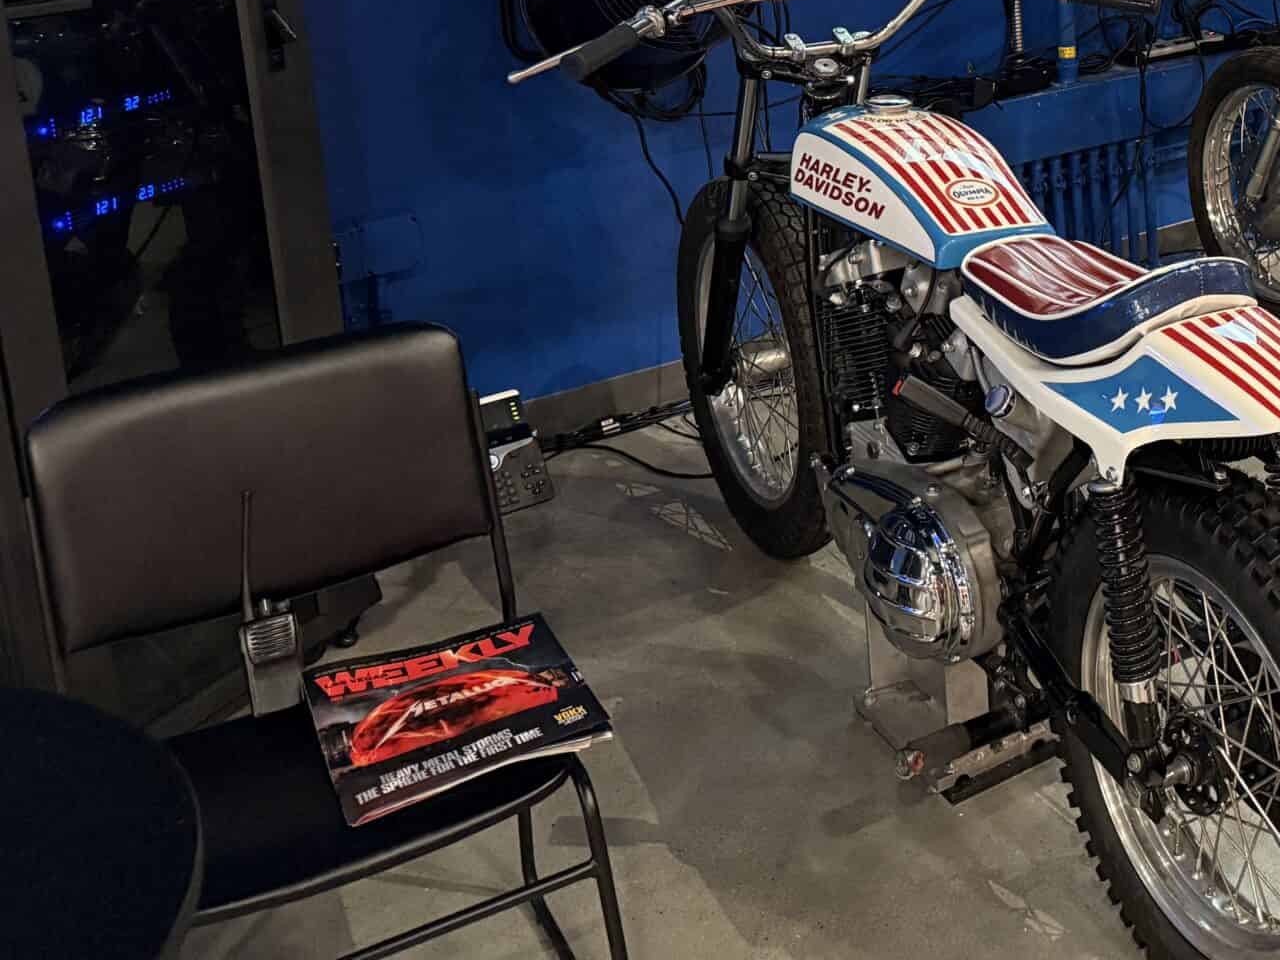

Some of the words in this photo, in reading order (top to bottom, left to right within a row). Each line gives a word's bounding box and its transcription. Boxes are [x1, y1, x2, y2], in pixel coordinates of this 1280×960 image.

[793, 167, 886, 220] DAVIDSON
[799, 152, 872, 193] HARLEY-
[313, 624, 536, 698] WEEKLY
[355, 787, 381, 805] THE
[381, 770, 430, 795] SPHERE
[430, 762, 455, 778] FOR
[456, 754, 481, 768] THE
[480, 739, 515, 759] FIRST
[515, 726, 544, 745] TIME
[380, 762, 421, 785] HEAVY
[422, 751, 464, 772] METAL
[462, 728, 513, 753] STORMS
